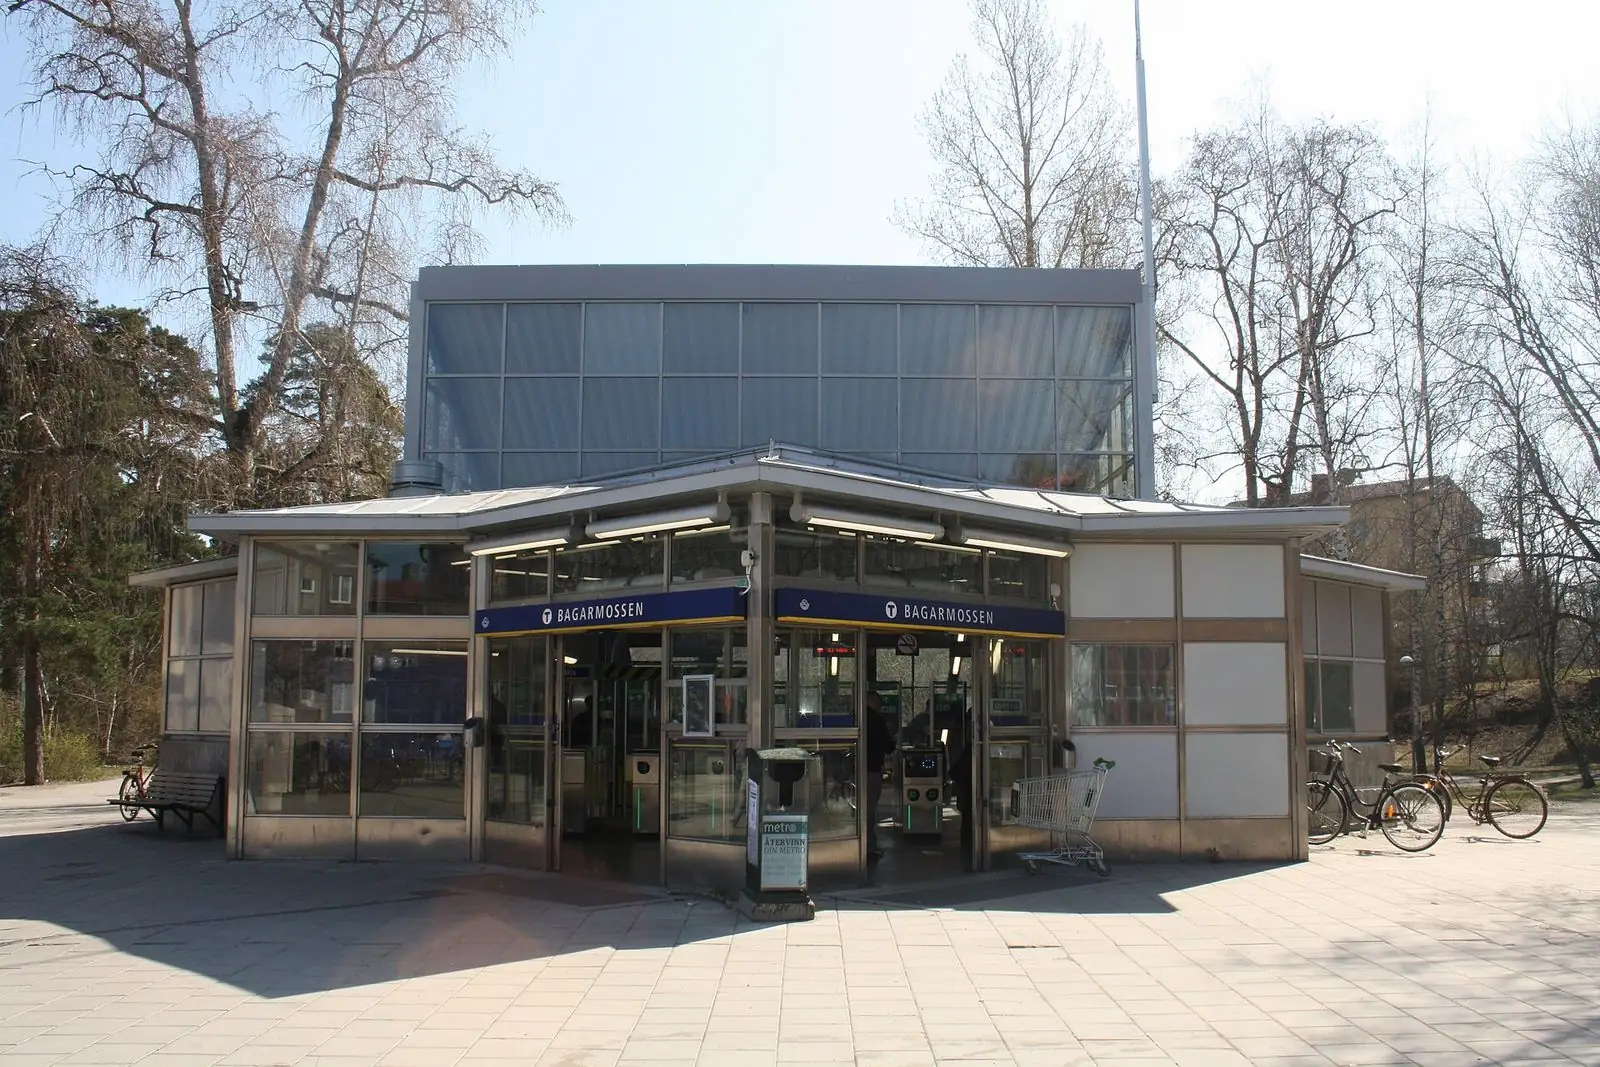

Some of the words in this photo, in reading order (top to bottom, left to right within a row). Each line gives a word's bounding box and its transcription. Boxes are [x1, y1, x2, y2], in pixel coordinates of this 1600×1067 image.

[544, 610, 551, 623] T
[557, 602, 644, 622] BAGARMOSSEN
[886, 603, 896, 617] T
[904, 604, 994, 624] BAGARMOSSEN
[764, 823, 797, 833] metro
[764, 836, 806, 846] ÅTERVINN
[764, 846, 777, 854] DIN
[780, 846, 806, 854] METRO
